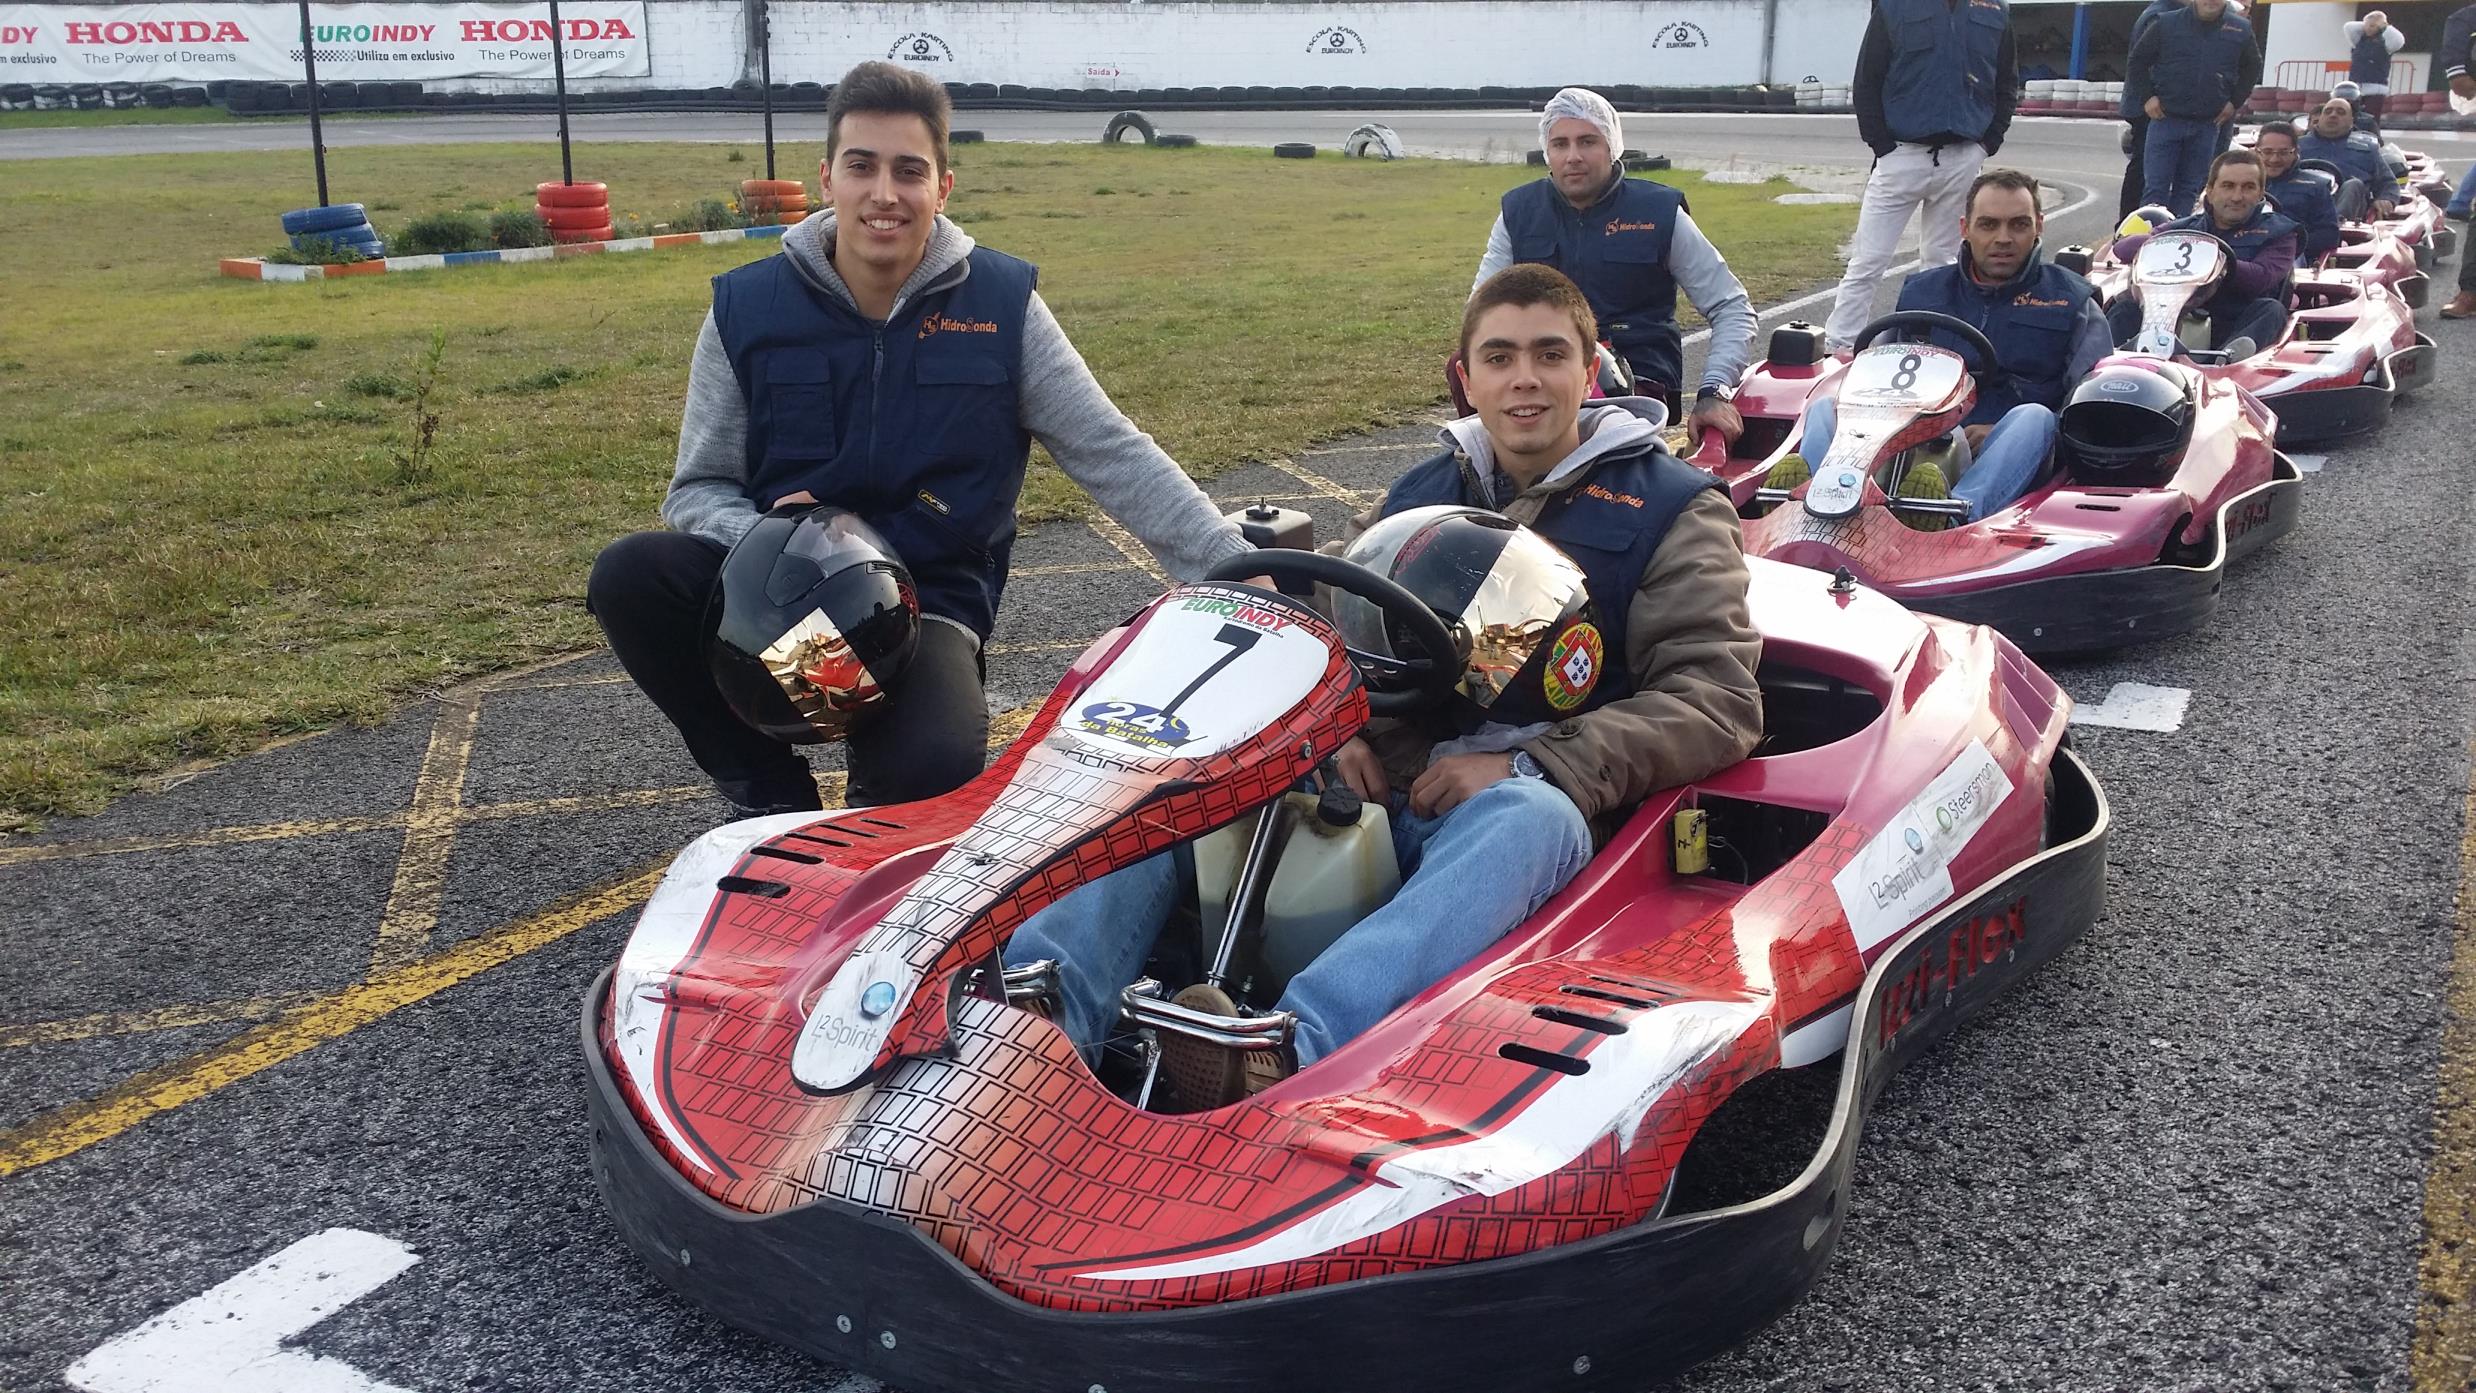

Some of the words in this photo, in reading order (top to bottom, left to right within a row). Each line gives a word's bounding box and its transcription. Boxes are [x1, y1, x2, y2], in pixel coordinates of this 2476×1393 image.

[64, 21, 249, 44] HONDA
[460, 19, 636, 42] HONDA
[1306, 27, 1332, 53] ESCOLA
[1338, 26, 1367, 54] KARTING
[1652, 22, 1677, 48] ESCOLA
[1681, 21, 1709, 47] KARTING
[11, 53, 57, 64] exclusivo
[83, 53, 110, 64] The
[115, 53, 158, 63] Power
[164, 51, 178, 63] of
[182, 51, 236, 62] Dreams
[357, 51, 389, 61] Utiliza
[393, 53, 408, 61] em
[411, 51, 455, 61] exclusivo
[479, 50, 505, 60] The
[510, 50, 552, 60] Power
[574, 49, 625, 59] Dreams
[888, 33, 916, 59] ESCOLA
[921, 32, 953, 62] KARTING
[2174, 242, 2193, 270] 3
[940, 317, 998, 333] HidroSonda
[1891, 354, 1922, 391] 8
[1181, 599, 1293, 631] EUROINDY
[1159, 623, 1263, 718] 7
[1093, 702, 1167, 733] 24
[1080, 720, 1101, 730] da
[1105, 726, 1169, 748] Batalha
[1948, 762, 1998, 820] Steersman
